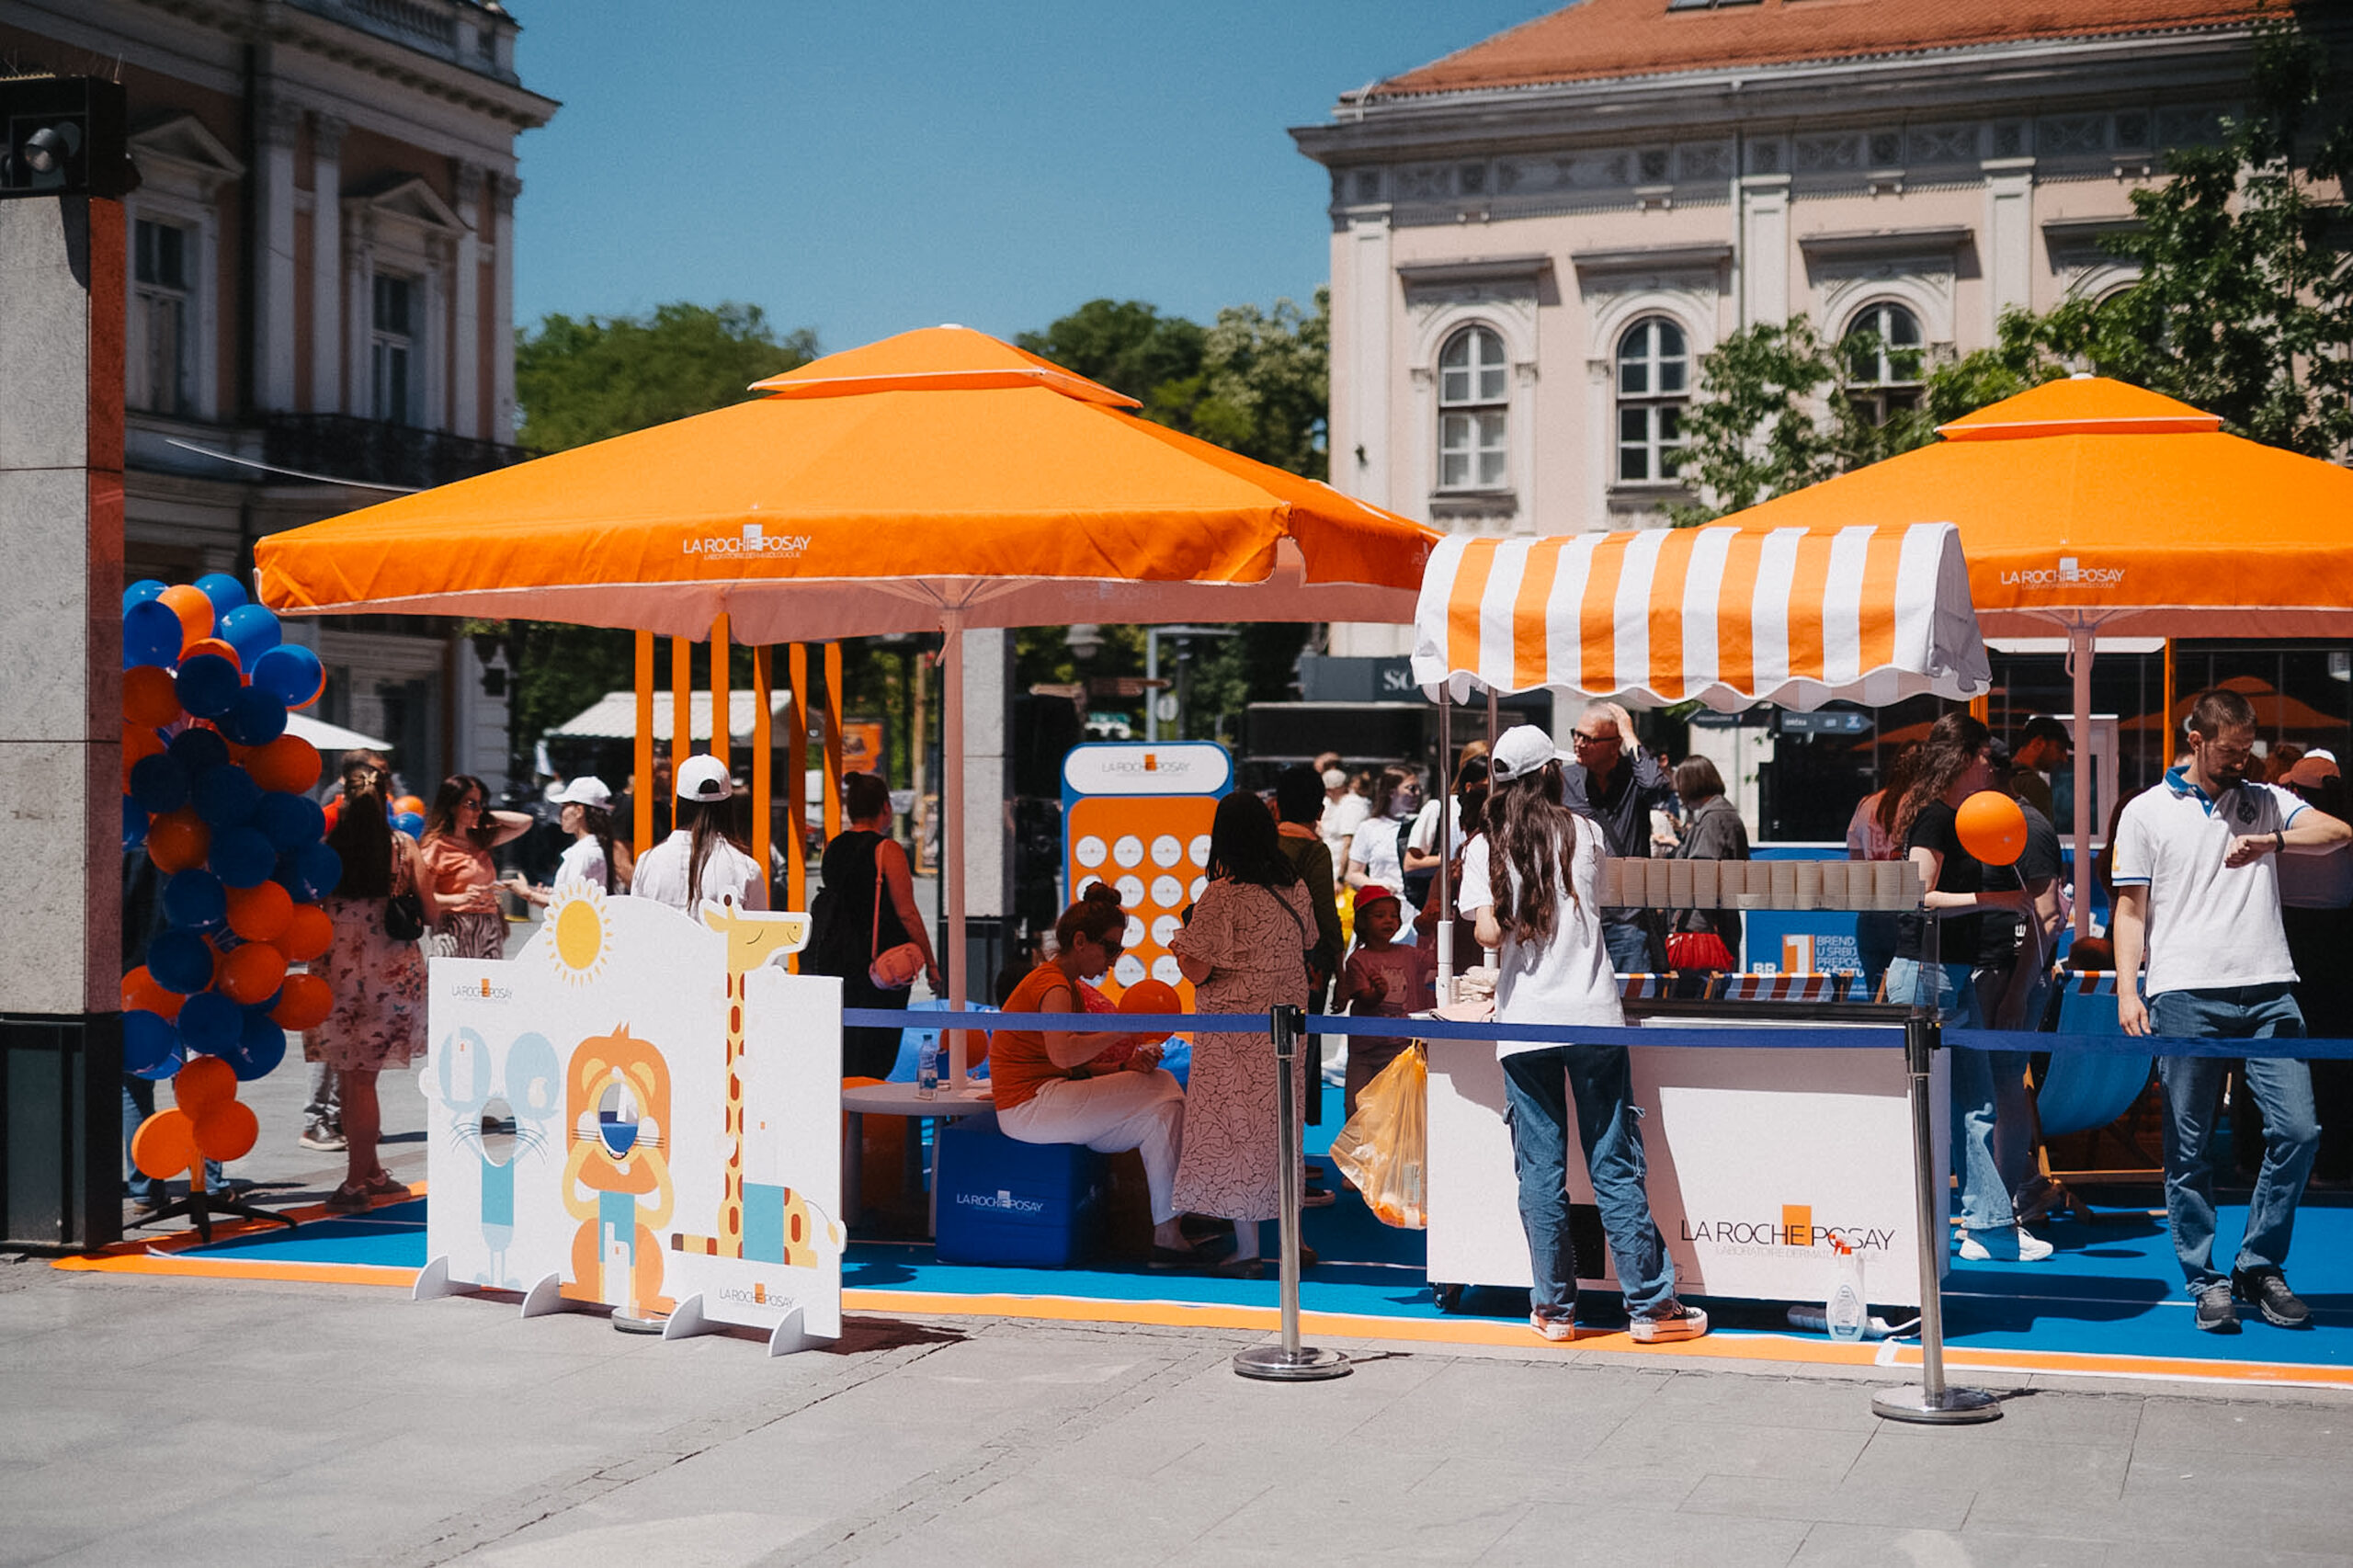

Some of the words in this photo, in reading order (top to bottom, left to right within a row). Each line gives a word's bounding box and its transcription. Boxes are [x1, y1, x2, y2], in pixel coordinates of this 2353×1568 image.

[683, 539, 702, 553] LA
[704, 538, 758, 552] ROCHE
[762, 535, 812, 551] POSAY
[2001, 571, 2020, 585] LA
[2022, 569, 2075, 584] ROCHE
[2077, 568, 2125, 583] POSAY
[1816, 937, 1856, 947] BREND
[1815, 947, 1825, 957] U
[956, 1194, 970, 1204] LA
[971, 1195, 1008, 1209] ROCHE
[1009, 1199, 1043, 1212] POSAY
[1681, 1220, 1711, 1242] LA
[1717, 1221, 1806, 1246] ROCHE
